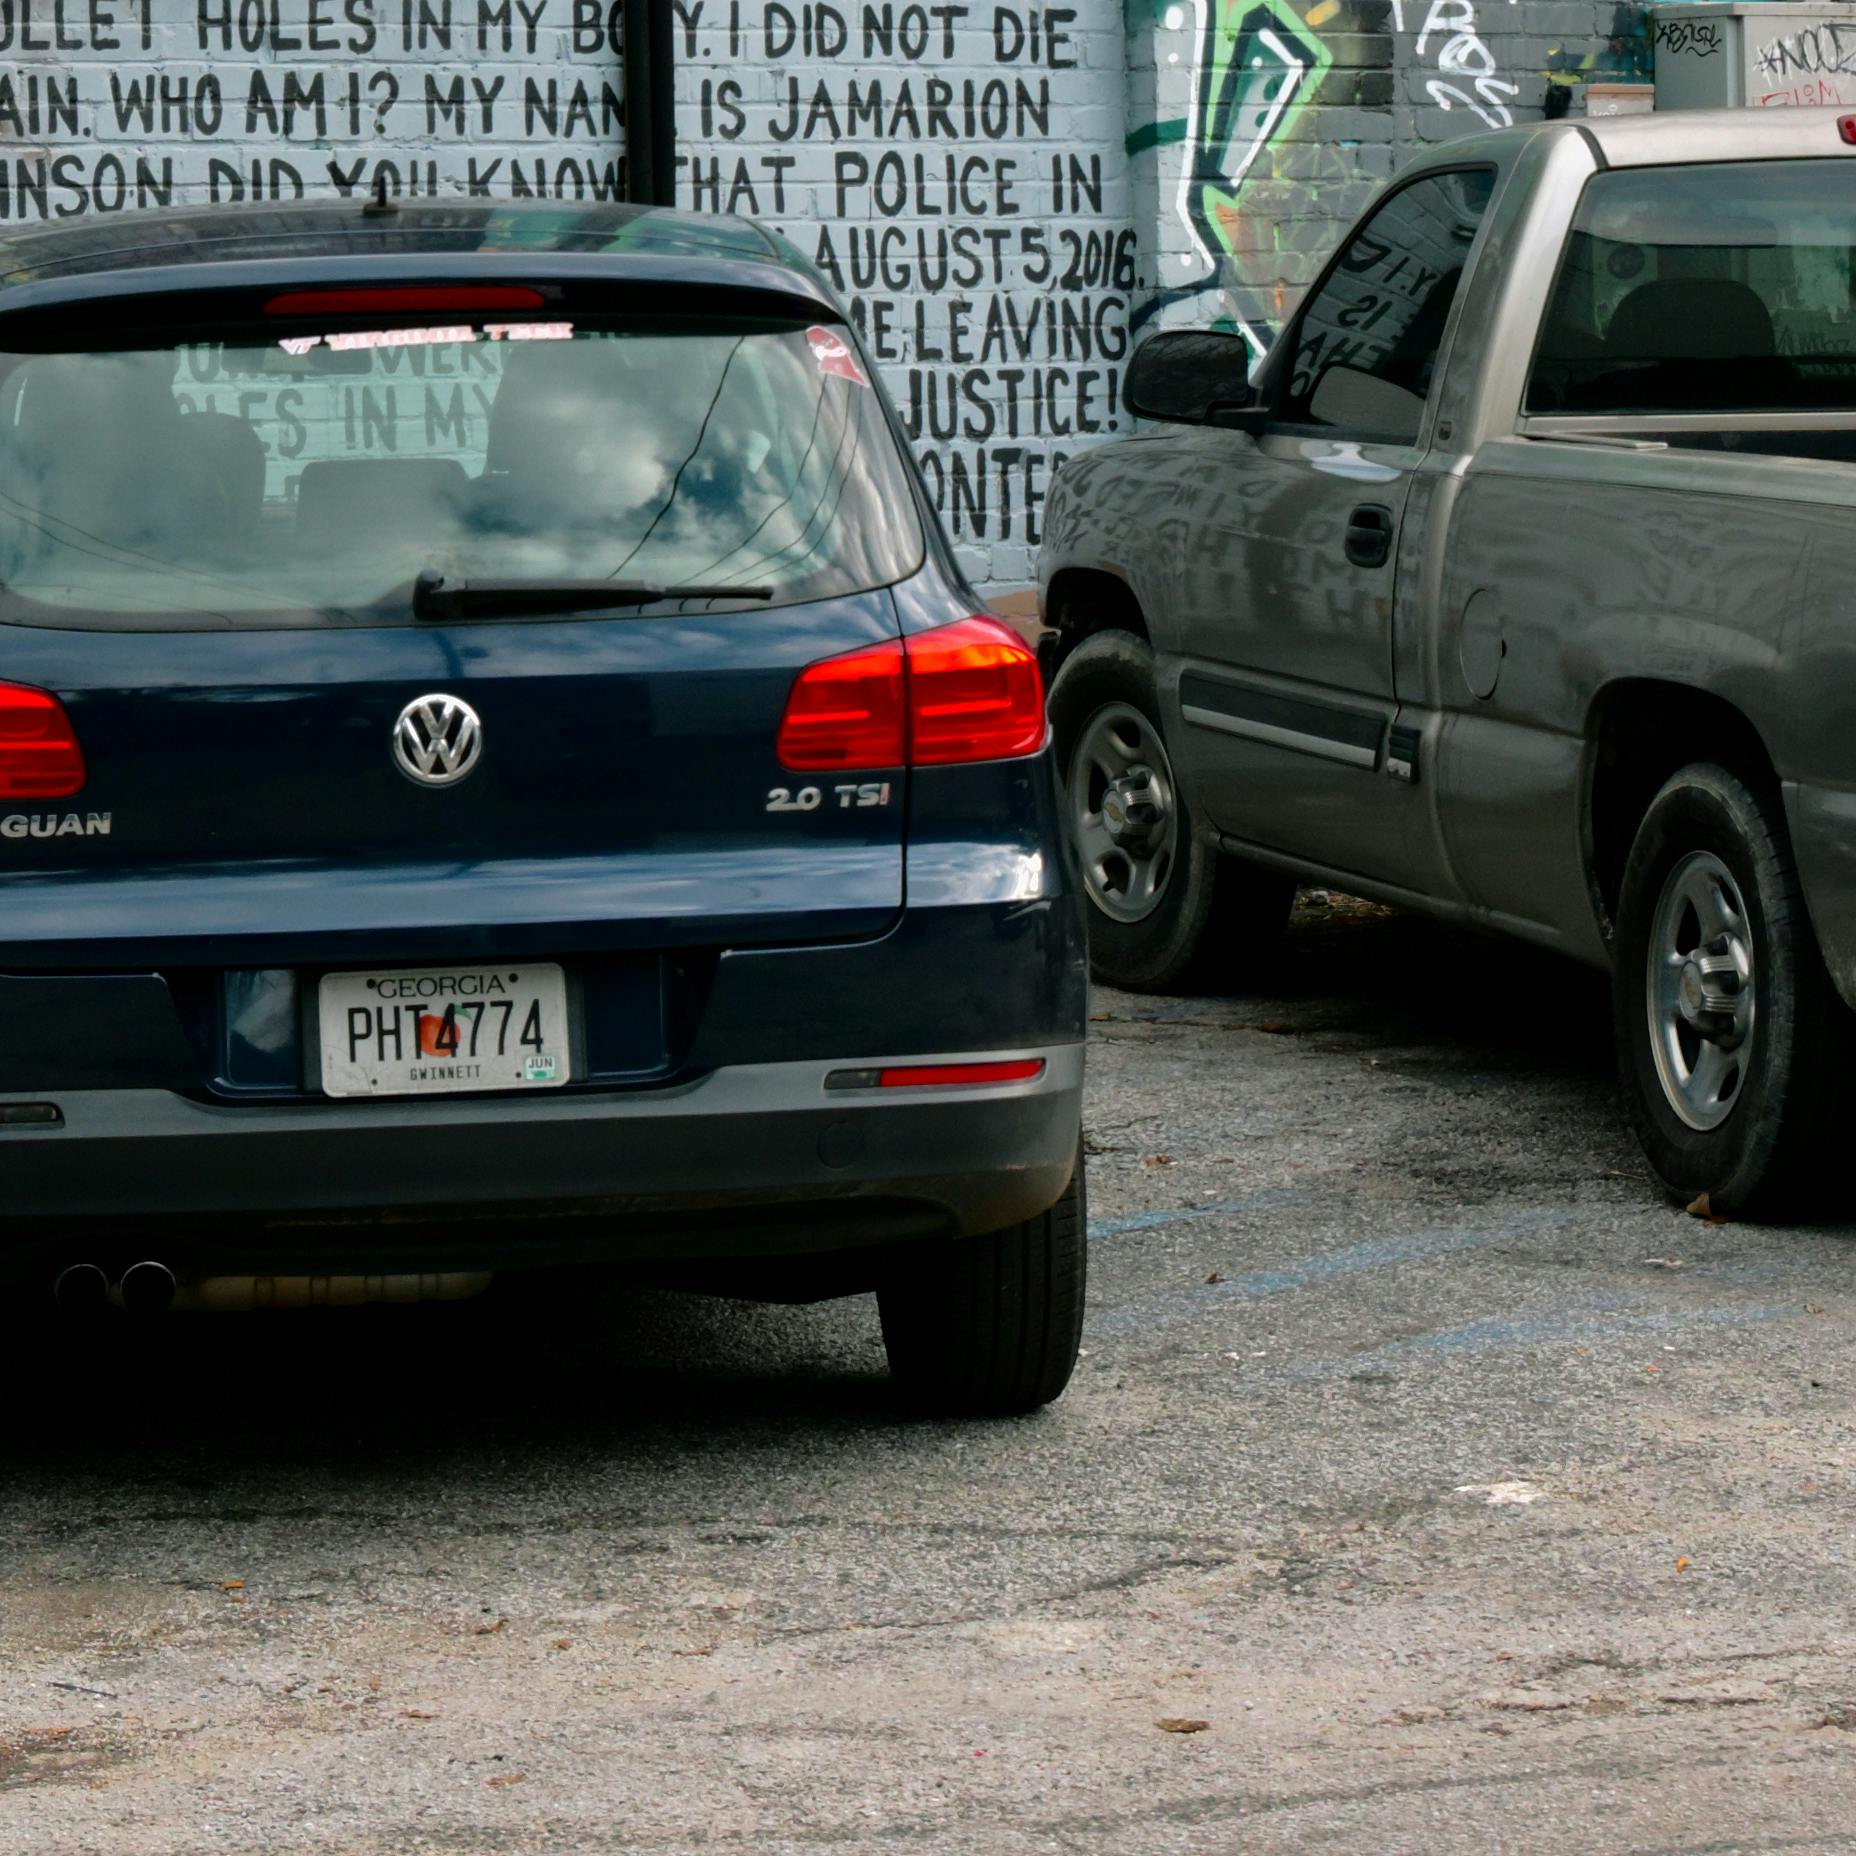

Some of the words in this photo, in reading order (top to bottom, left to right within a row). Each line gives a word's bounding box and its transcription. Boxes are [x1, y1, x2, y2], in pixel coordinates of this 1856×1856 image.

[730, 0, 740, 57] I
[764, 1, 847, 59] DID
[863, 4, 968, 60] NOT
[994, 5, 1078, 69] DIE
[110, 74, 223, 136] WHO
[245, 70, 328, 137] AM
[349, 71, 400, 136] I?
[425, 74, 505, 137] MY
[701, 78, 746, 140] IS
[768, 78, 1050, 142] JAMARION
[210, 158, 303, 205] DID
[327, 157, 437, 201] YOU
[469, 155, 627, 203] KNOW
[835, 151, 1017, 219] POLICE
[1053, 153, 1102, 214] IN
[815, 225, 1012, 291] AUGUST
[915, 295, 1127, 363] LEAVING
[898, 368, 1119, 443] JUSTICE!
[766, 787, 821, 812] 2.0
[834, 783, 891, 807] TSI
[377, 974, 506, 999] GEORGIA
[347, 998, 544, 1063] PHT4774
[410, 1065, 481, 1081] GWINNETT
[529, 1058, 553, 1069] JUN
